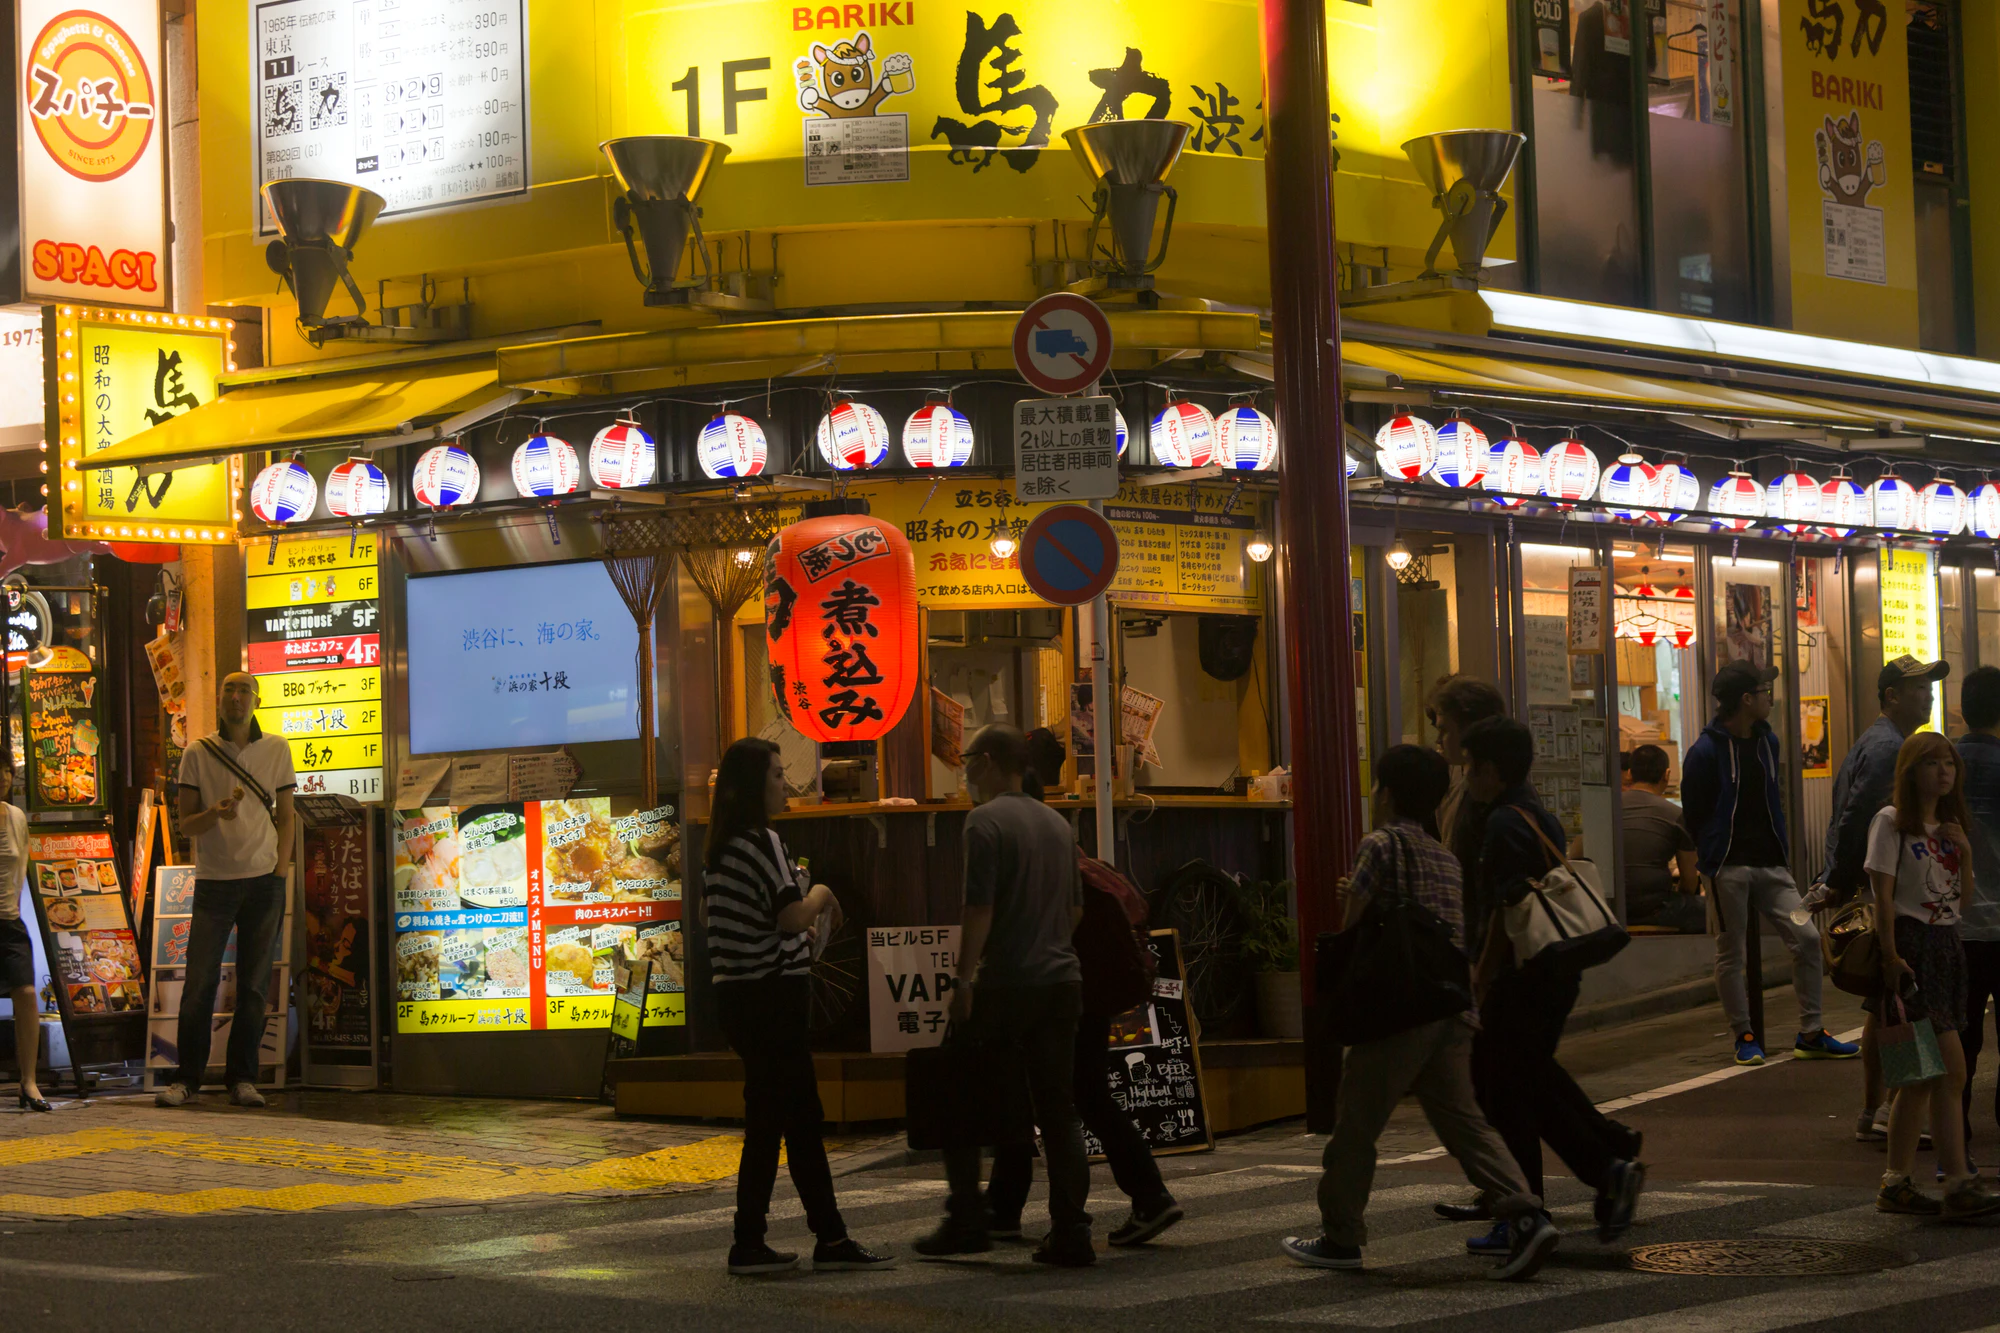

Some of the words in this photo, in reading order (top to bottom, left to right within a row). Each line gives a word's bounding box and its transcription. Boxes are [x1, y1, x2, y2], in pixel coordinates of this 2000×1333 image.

[793, 2, 914, 31] BARIKI
[1534, 1, 1562, 20] COLD
[475, 12, 508, 29] 390円
[42, 23, 90, 59] Spaghetti
[92, 25, 104, 38] &
[105, 33, 136, 77] Cheese
[265, 35, 292, 56] 東京
[475, 41, 508, 58] 590円
[1710, 3, 1729, 83] ホッピー
[297, 56, 328, 73] レース
[31, 65, 153, 128] スパチー
[671, 57, 771, 136] 1F
[1811, 70, 1883, 111] BARIKI
[67, 149, 94, 166] SINCE
[97, 155, 116, 166] 1973
[33, 240, 157, 292] SPACI
[1020, 404, 1111, 426] 最大積載量
[838, 427, 858, 438] Asahi
[860, 408, 878, 448] アサヒビール
[1192, 430, 1210, 440] Asahi
[709, 442, 727, 452] Asahi
[734, 422, 748, 462] アサヒビール
[938, 418, 948, 462] アサヒビール
[1020, 427, 1112, 449] 2t以上の貨物
[1168, 419, 1186, 462] アサヒビール
[1221, 419, 1230, 462] アサヒビール
[1396, 442, 1416, 451] Asahi
[1419, 424, 1432, 463] アサヒビール
[601, 457, 620, 466] Asahi
[1020, 450, 1112, 472] 居住者用車両
[1464, 432, 1472, 472] アサヒビール
[428, 450, 441, 488] アサヒビール
[447, 466, 466, 476] Asahi
[530, 466, 549, 474] Asahi
[557, 447, 566, 488] アサヒビール
[626, 443, 640, 484] アサヒビール
[1550, 453, 1560, 492] アサヒビール
[265, 468, 282, 505] アサヒビール
[354, 475, 364, 514] アサヒビール
[1022, 476, 1071, 496] を除く
[288, 544, 338, 556] モンド・バリュー
[358, 546, 372, 559] 7F
[358, 577, 373, 590] 6F
[266, 618, 290, 632] VAPE
[300, 614, 332, 629] HOUSE
[352, 608, 376, 628] 5F
[286, 630, 312, 639] SHIBUYA
[284, 640, 344, 655] 水たばこカフェ
[346, 637, 379, 664] 4F
[326, 656, 338, 664] 入口
[818, 580, 884, 729] 煮込み
[283, 682, 305, 697] BBQ
[308, 680, 346, 694] ブッチャー
[361, 677, 376, 690] 3F
[792, 680, 812, 711] 渋谷
[362, 710, 376, 723] 2F
[303, 742, 332, 767] 馬力
[363, 744, 378, 757] 1F
[350, 778, 380, 795] B1F
[329, 838, 340, 915] シーシャカフェ
[616, 878, 668, 890] サイコロステーキ
[548, 882, 592, 893] ポークチョップ
[584, 893, 604, 901] ¥980
[654, 890, 672, 898] ¥880
[432, 900, 451, 908] ¥980
[500, 897, 518, 905] ¥590
[576, 906, 652, 920] 肉のエキスパート!!
[870, 929, 950, 948] 当ビル5F
[412, 991, 432, 999] ¥390
[502, 988, 521, 996] ¥590
[565, 986, 584, 994] ¥690
[656, 983, 676, 991] ¥980
[399, 1005, 414, 1018] 2F
[550, 1000, 565, 1014] 3F
[312, 1009, 336, 1031] 4F
[1157, 1062, 1192, 1076] BEER
[1130, 1085, 1172, 1101] Highball
